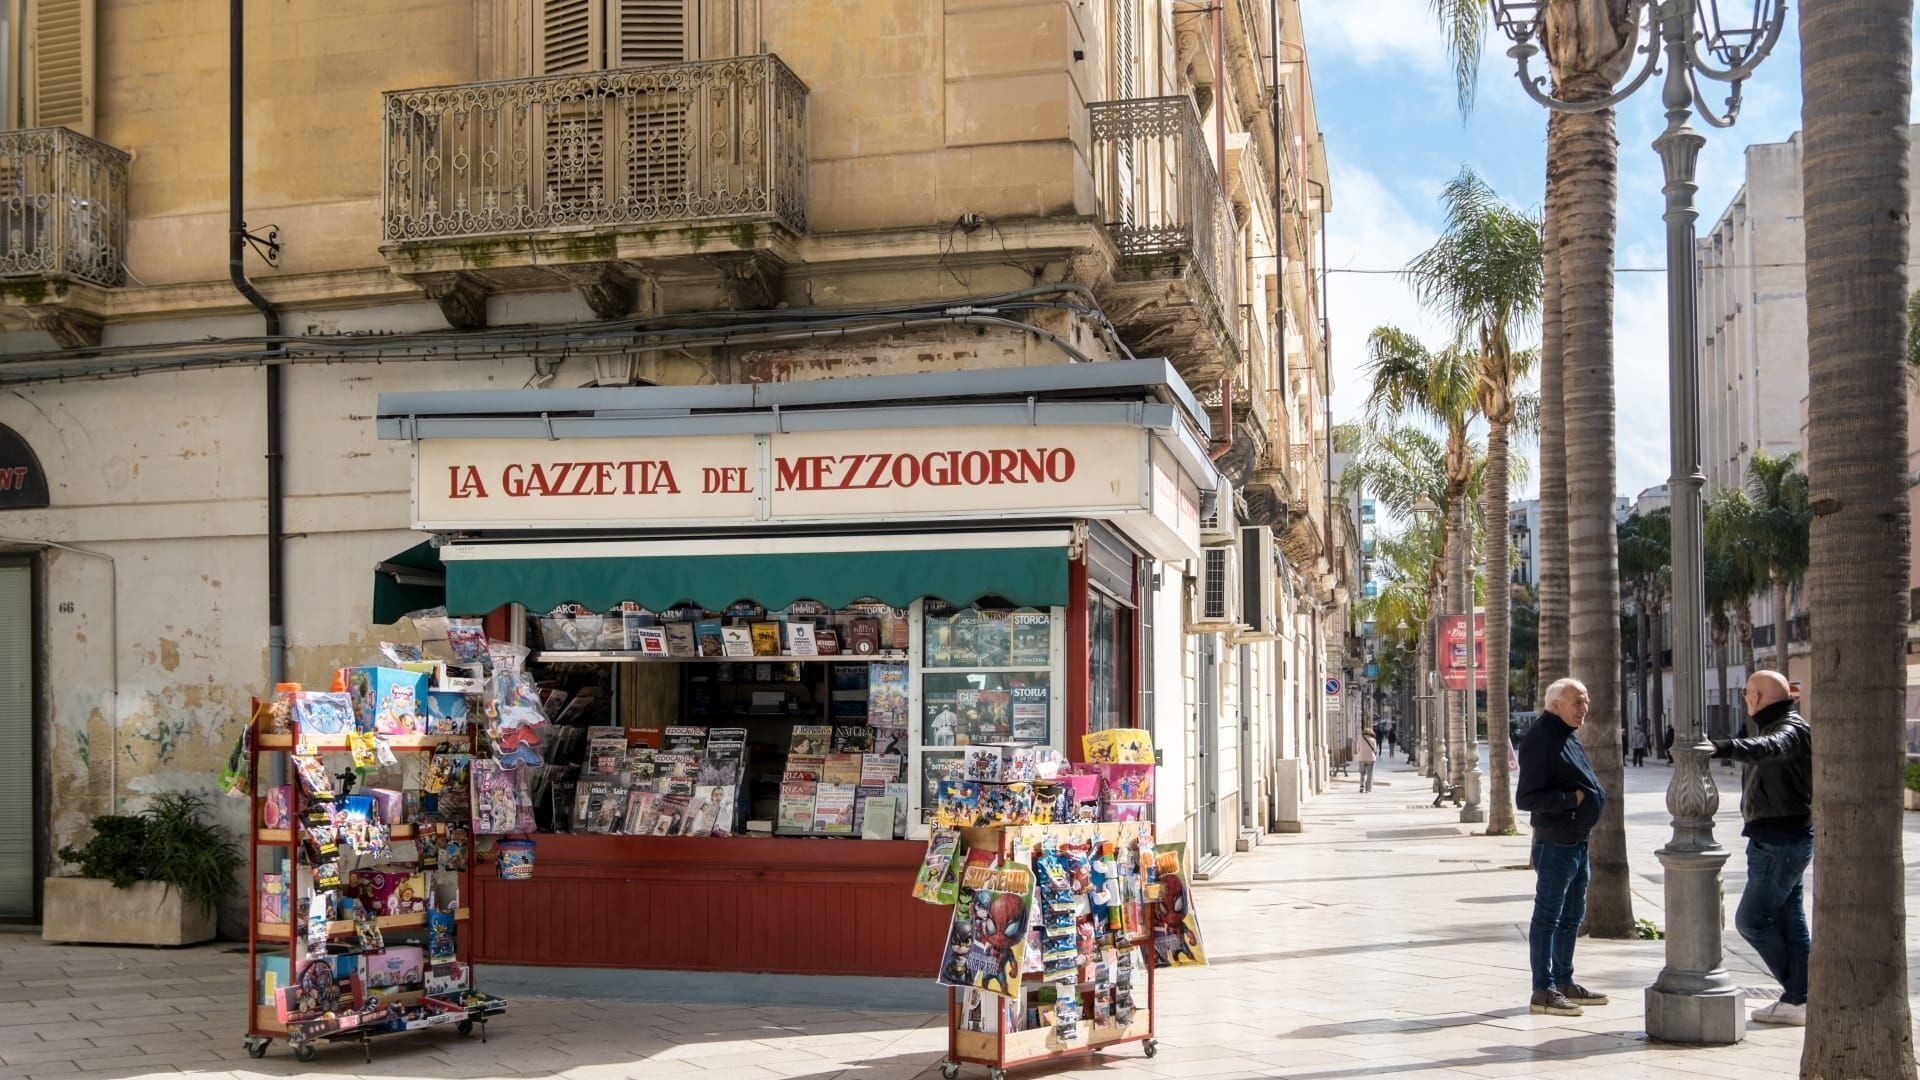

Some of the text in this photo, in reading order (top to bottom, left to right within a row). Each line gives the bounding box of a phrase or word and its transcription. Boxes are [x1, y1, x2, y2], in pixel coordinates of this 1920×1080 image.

[448, 447, 1076, 500] LA GAZZETTA DEL MEZZOGIORNO
[58, 601, 75, 614] 66
[1014, 614, 1050, 625] STORICA
[1014, 688, 1047, 697] STORIA
[782, 785, 804, 794] RIZA
